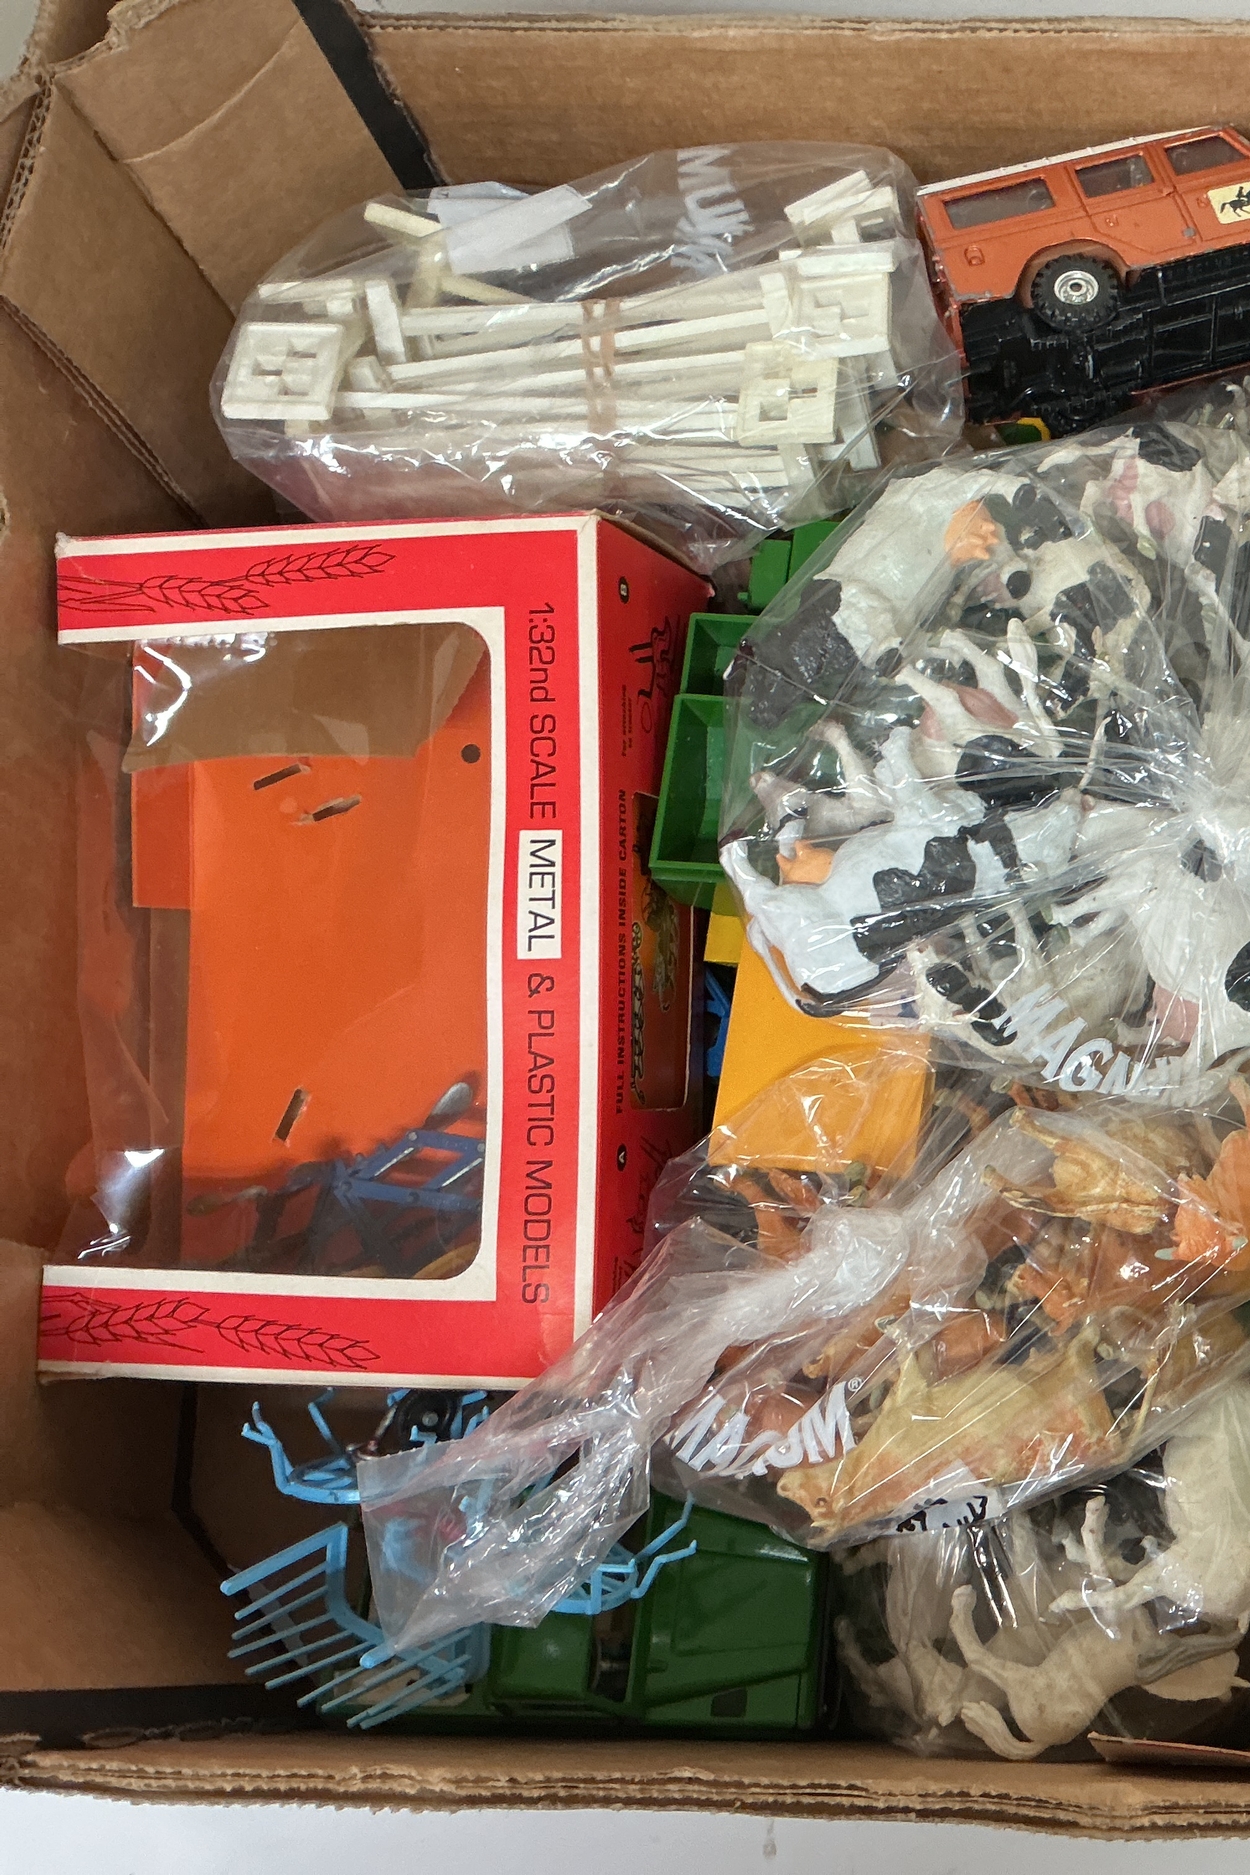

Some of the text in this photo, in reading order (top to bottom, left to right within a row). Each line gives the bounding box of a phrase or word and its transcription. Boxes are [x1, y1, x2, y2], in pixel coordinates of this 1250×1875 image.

[521, 601, 558, 1305] 1:32nd SCALE METAL & PLASTIC MODELS
[616, 789, 628, 1115] FULL INSTRUCTIONS INSIDE CARTON
